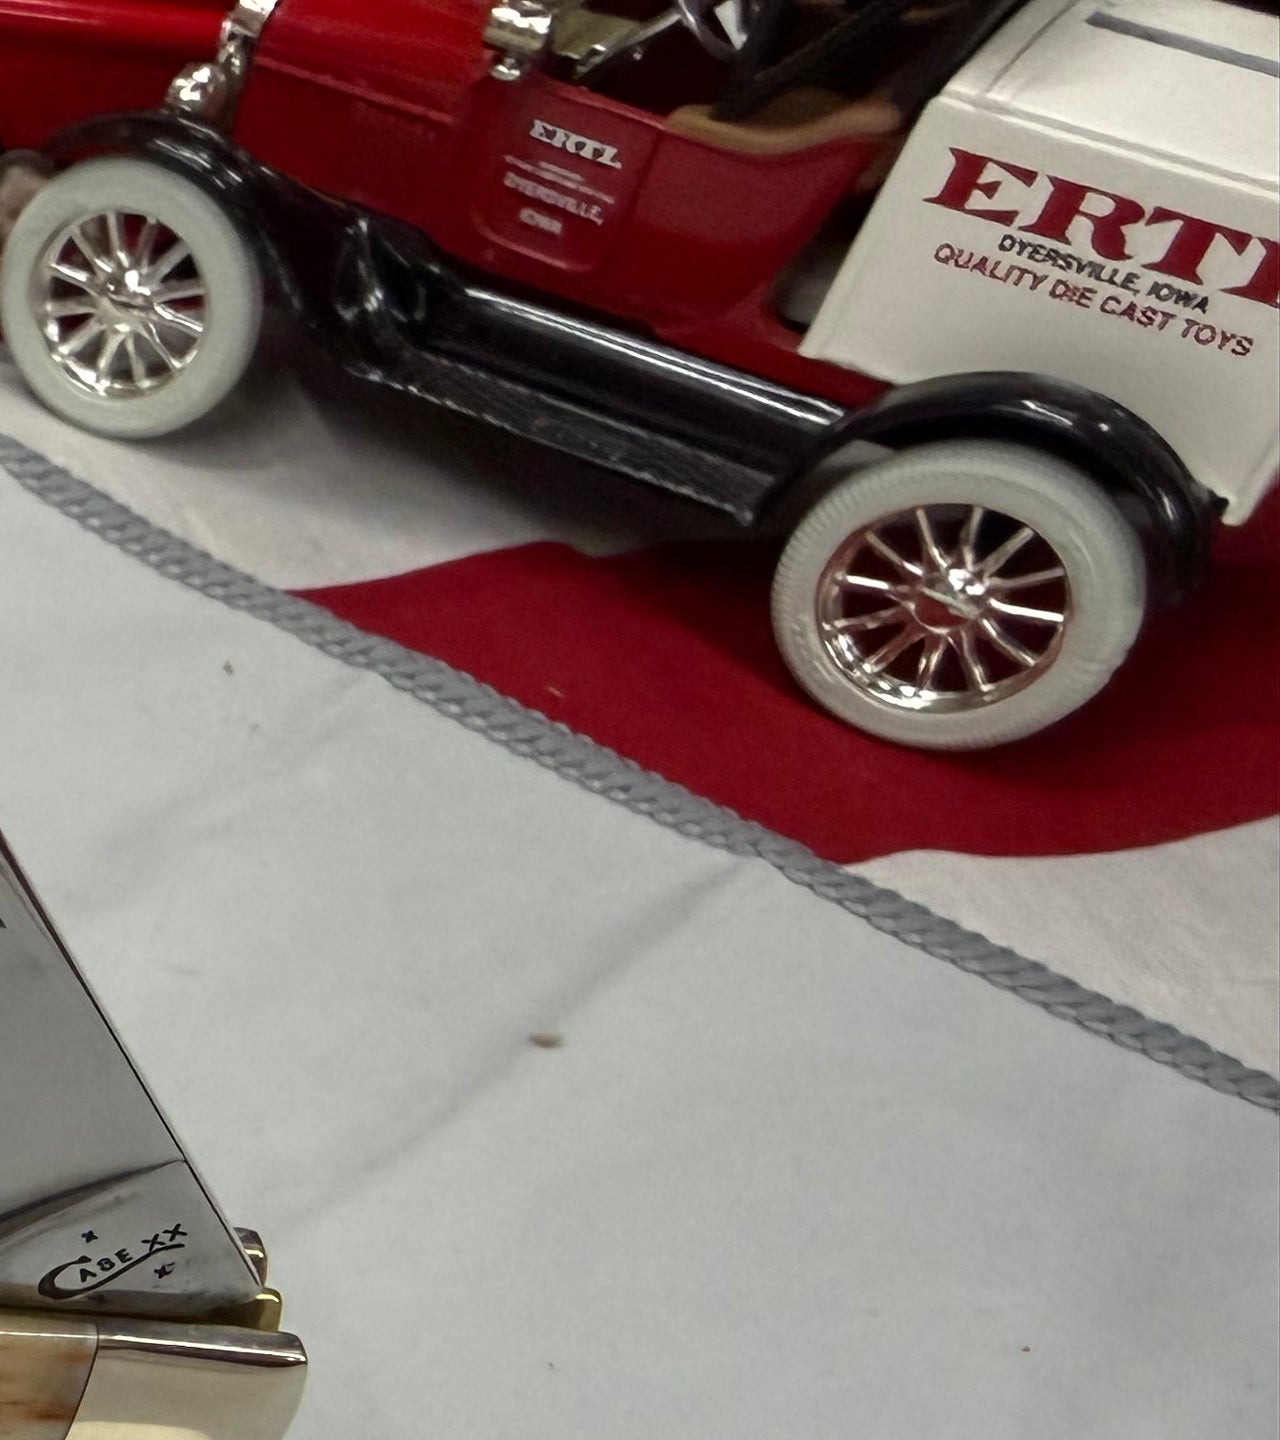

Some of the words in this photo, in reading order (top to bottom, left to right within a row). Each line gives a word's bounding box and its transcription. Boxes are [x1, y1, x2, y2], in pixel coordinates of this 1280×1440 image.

[529, 119, 623, 169] ERTL
[934, 242, 1048, 291] QUALITY
[1049, 279, 1097, 308] DIE
[1100, 295, 1176, 331] CAST
[1181, 317, 1253, 357] TOYS
[1146, 281, 1209, 314] IOWA
[141, 1223, 188, 1253] XX
